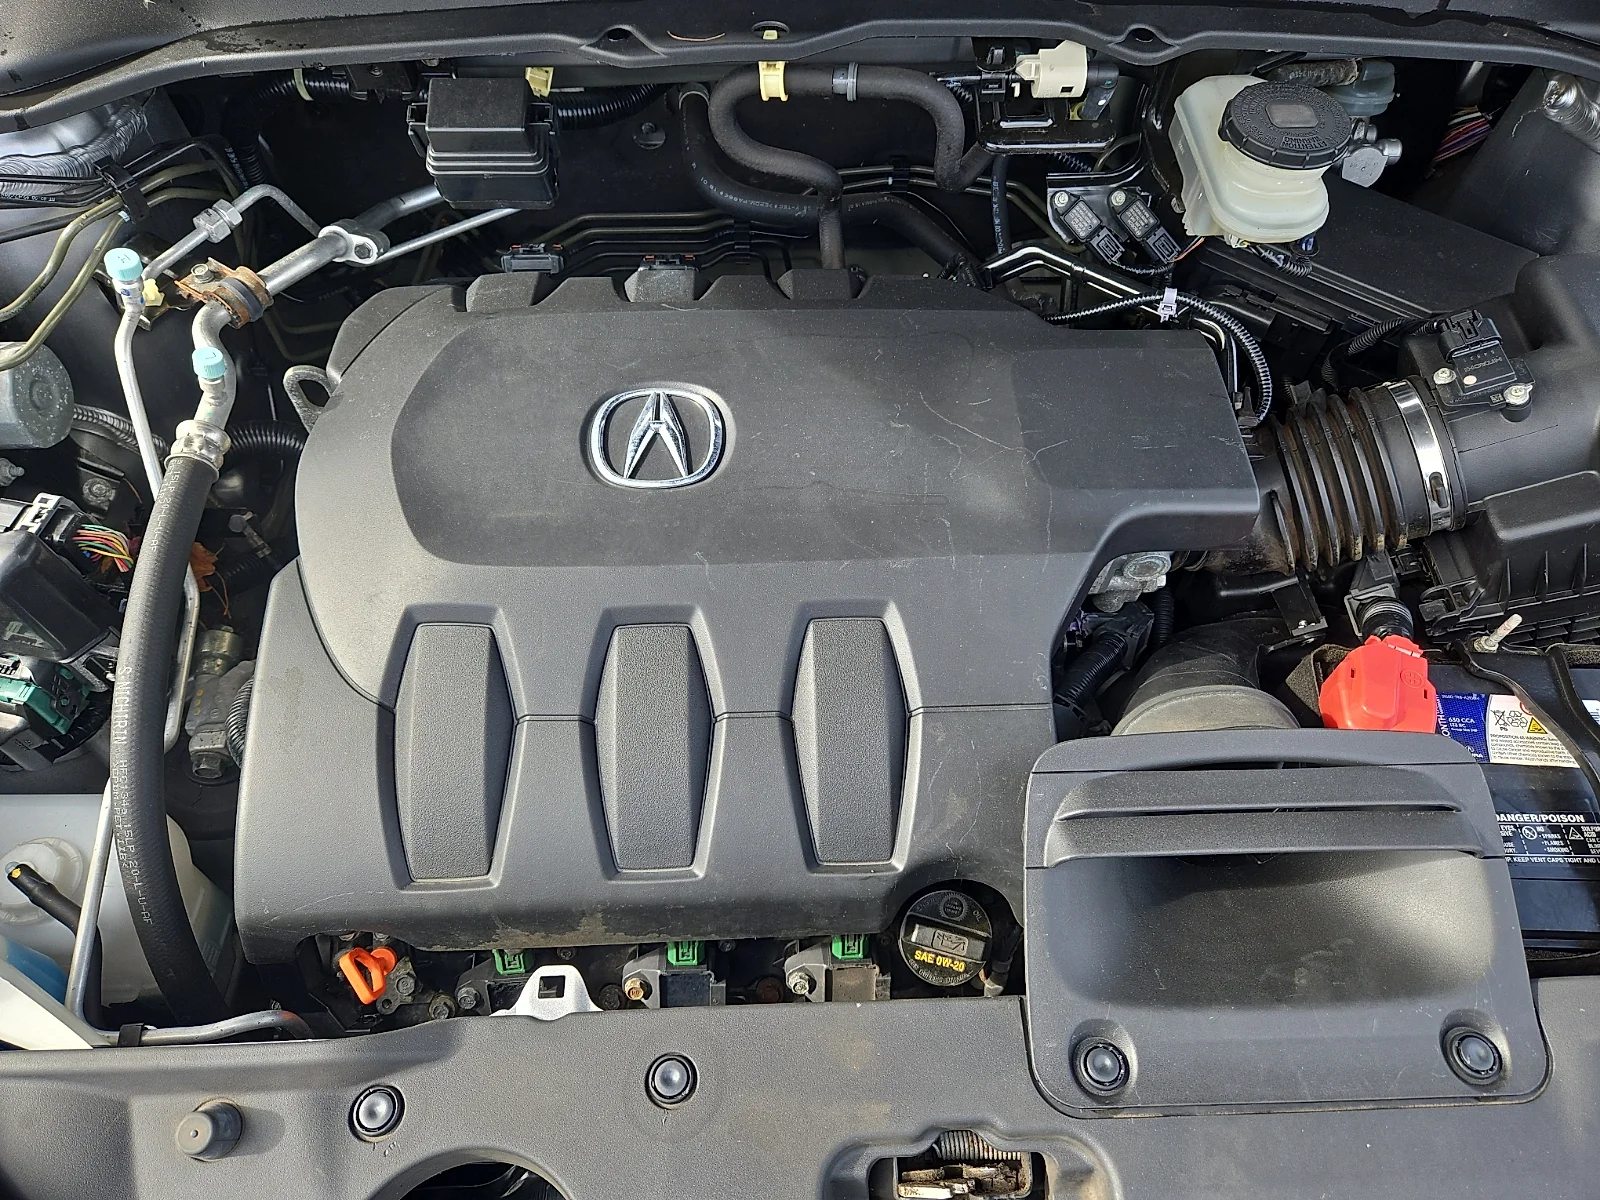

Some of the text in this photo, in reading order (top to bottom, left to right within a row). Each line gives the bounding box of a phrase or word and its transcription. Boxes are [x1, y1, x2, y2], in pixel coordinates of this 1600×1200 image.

[1464, 356, 1502, 372] HITACHI
[972, 910, 984, 922] OIL
[914, 950, 966, 973] SAE 0W-20
